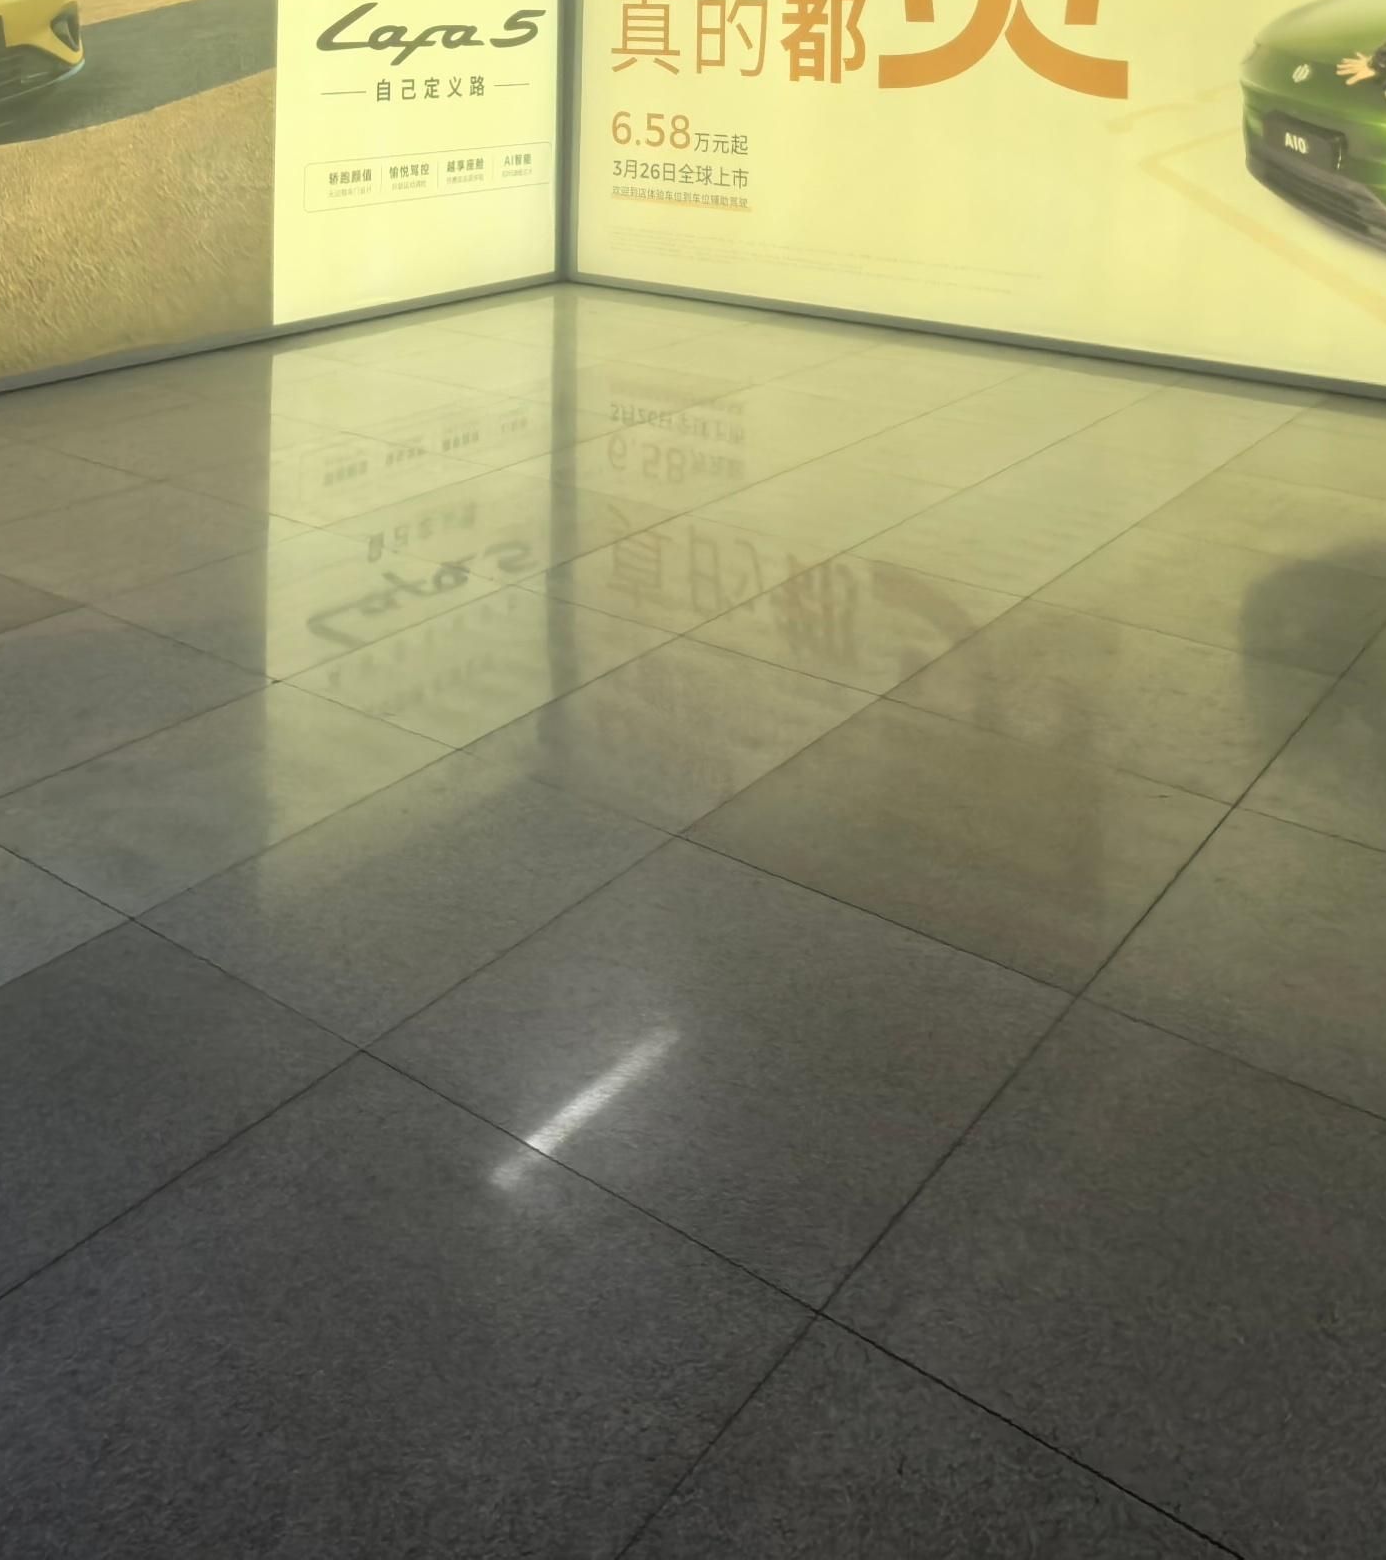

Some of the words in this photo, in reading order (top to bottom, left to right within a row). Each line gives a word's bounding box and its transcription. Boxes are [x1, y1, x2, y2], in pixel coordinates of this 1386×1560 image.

[375, 74, 486, 102] 自己定义路
[611, 110, 749, 156] 6.58万元起
[611, 159, 749, 189] 3月26日全球上市
